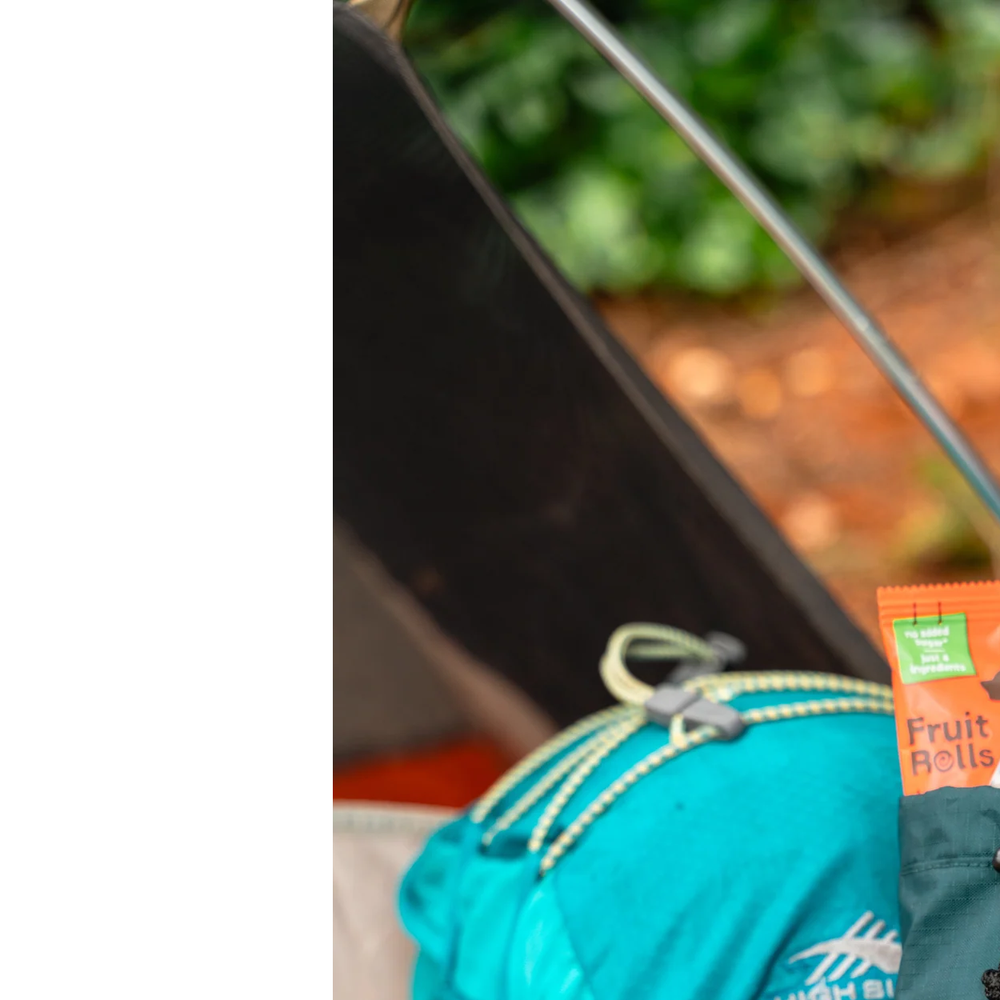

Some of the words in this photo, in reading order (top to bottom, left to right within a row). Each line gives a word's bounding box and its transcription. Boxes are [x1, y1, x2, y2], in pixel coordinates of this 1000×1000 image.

[920, 625, 949, 638] added
[909, 663, 966, 675] ingredients
[907, 711, 989, 746] Fruit
[911, 743, 995, 776] Rolls
